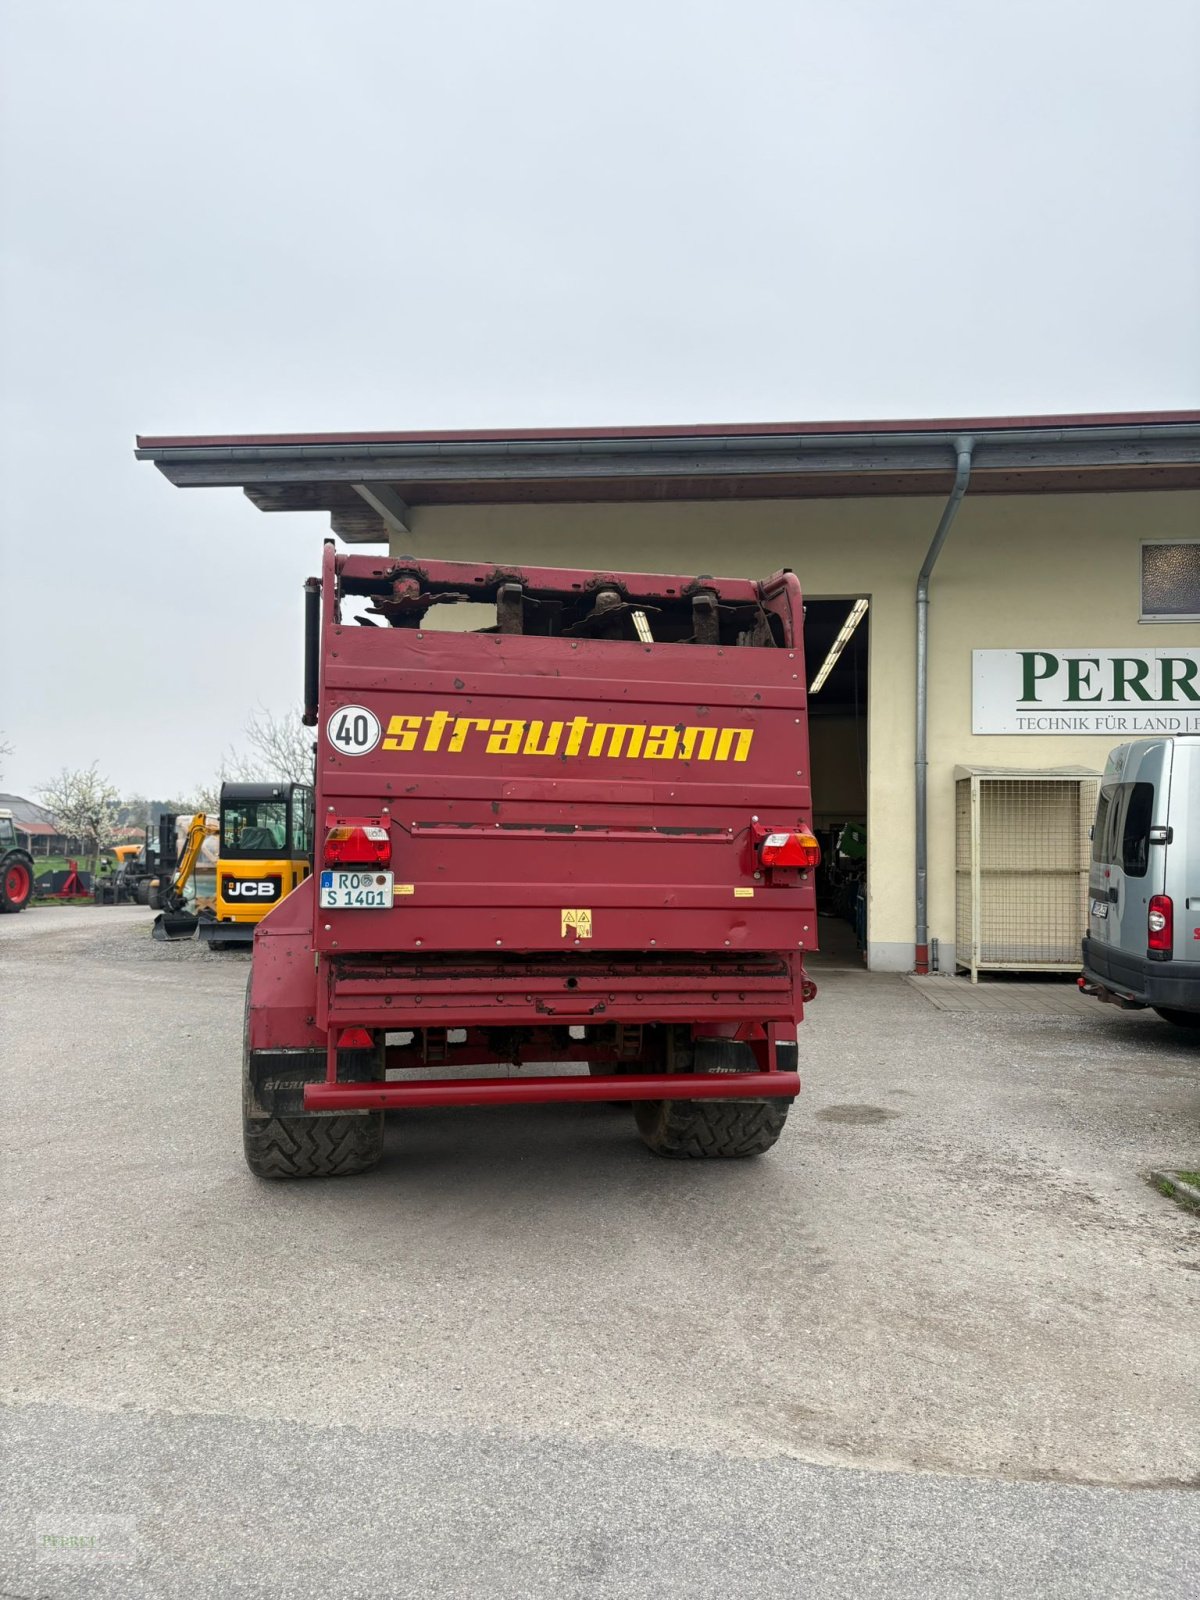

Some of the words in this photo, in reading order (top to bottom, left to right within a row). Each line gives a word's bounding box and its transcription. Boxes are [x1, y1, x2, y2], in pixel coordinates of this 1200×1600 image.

[336, 714, 368, 746] 40
[1016, 717, 1088, 730] TECHNIK
[1095, 714, 1127, 730] FÜR
[1133, 717, 1181, 730] LAND
[381, 710, 754, 762] strautmann
[228, 882, 275, 896] JCB
[338, 874, 360, 889] RO
[327, 890, 337, 905] S
[344, 890, 385, 906] 1401
